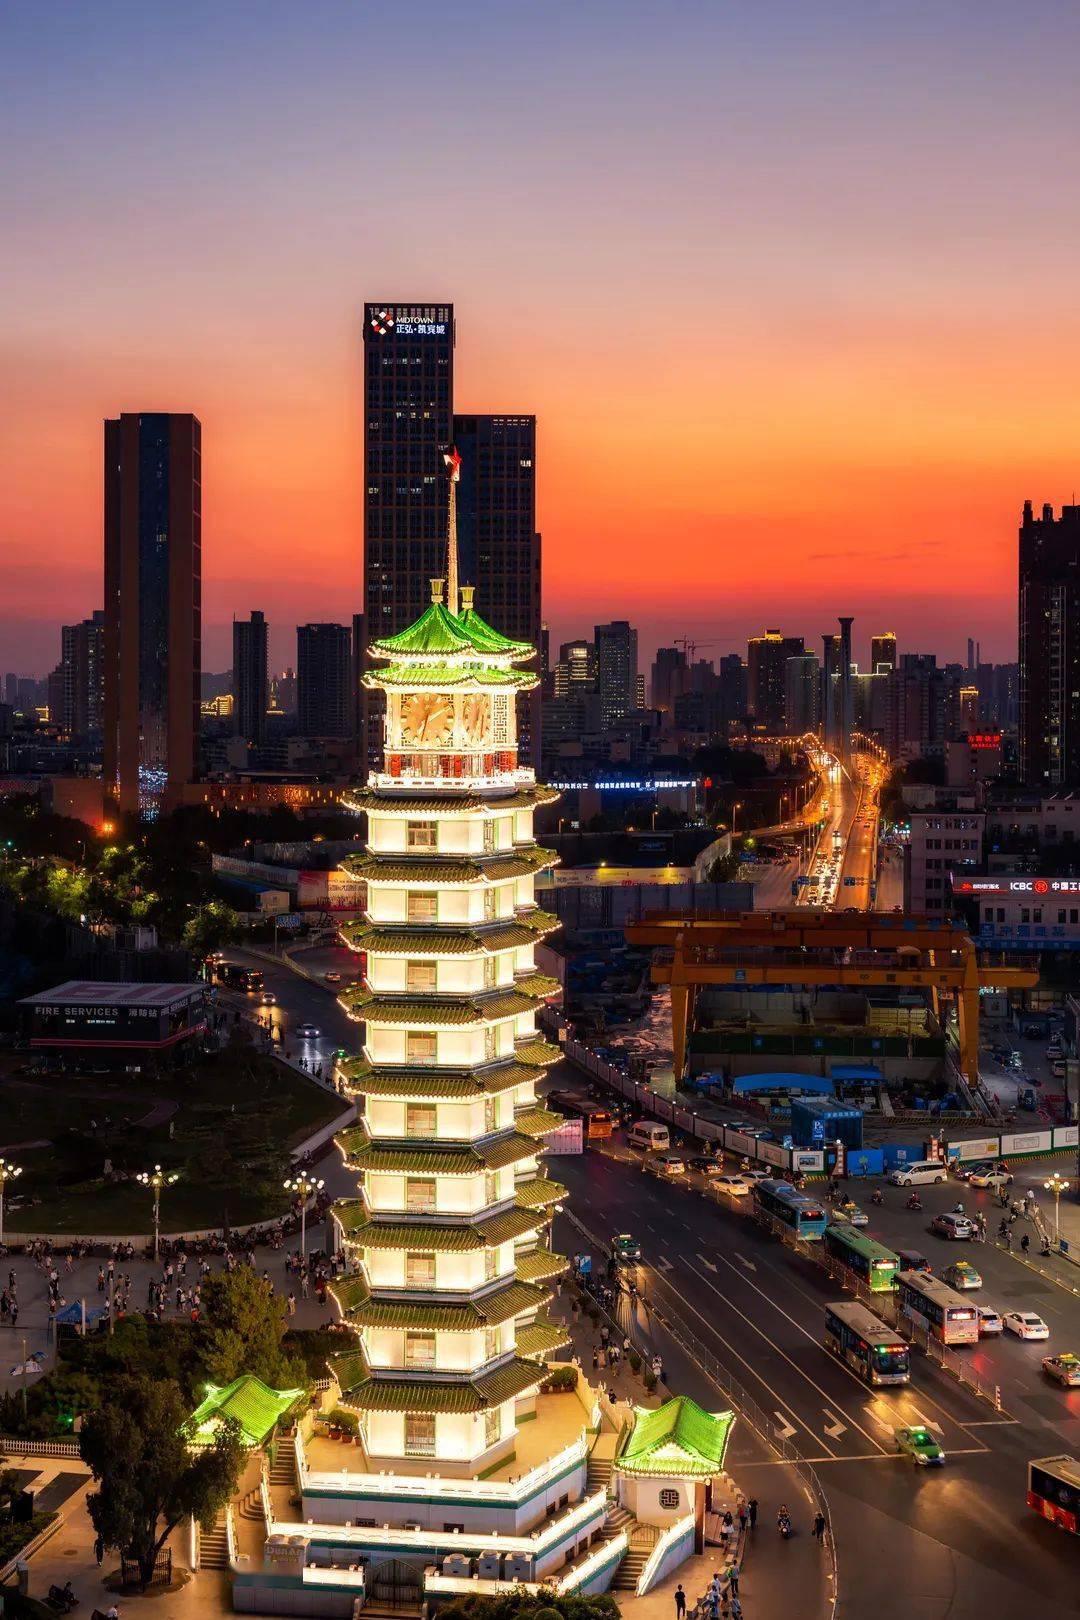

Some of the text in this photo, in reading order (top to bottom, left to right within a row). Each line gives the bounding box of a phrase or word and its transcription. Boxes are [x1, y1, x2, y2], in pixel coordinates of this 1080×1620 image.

[396, 316, 434, 324] MIDTOWN
[1010, 882, 1032, 890] ICBC
[1051, 881, 1080, 891] 中国工
[35, 1007, 119, 1016] FIRE SERVICES
